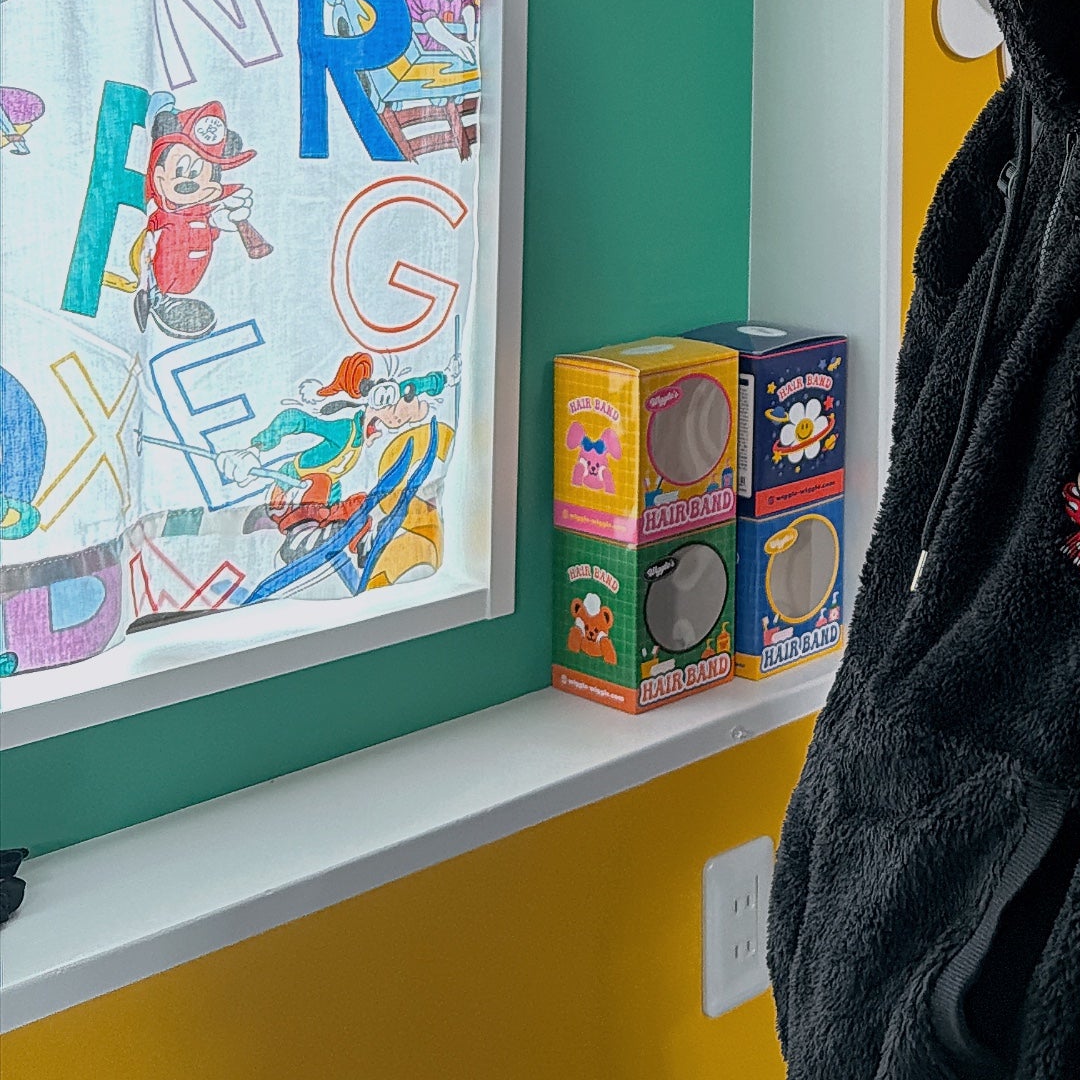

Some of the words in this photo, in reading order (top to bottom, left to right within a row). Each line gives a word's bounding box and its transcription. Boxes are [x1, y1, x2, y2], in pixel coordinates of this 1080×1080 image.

[331, 175, 469, 354] G
[569, 397, 592, 414] HAIR
[594, 399, 619, 420] BAND
[778, 376, 803, 400] HAIR
[805, 374, 832, 390] BAND
[149, 319, 297, 512] E
[34, 351, 143, 531] X
[644, 502, 688, 533] HAIR
[688, 489, 733, 521] BAND
[568, 565, 591, 581] HAIR
[593, 566, 619, 593] BAND
[762, 638, 800, 670] HAIR
[800, 622, 839, 655] BAND
[641, 670, 684, 703] HAIR
[685, 654, 730, 688] BAND
